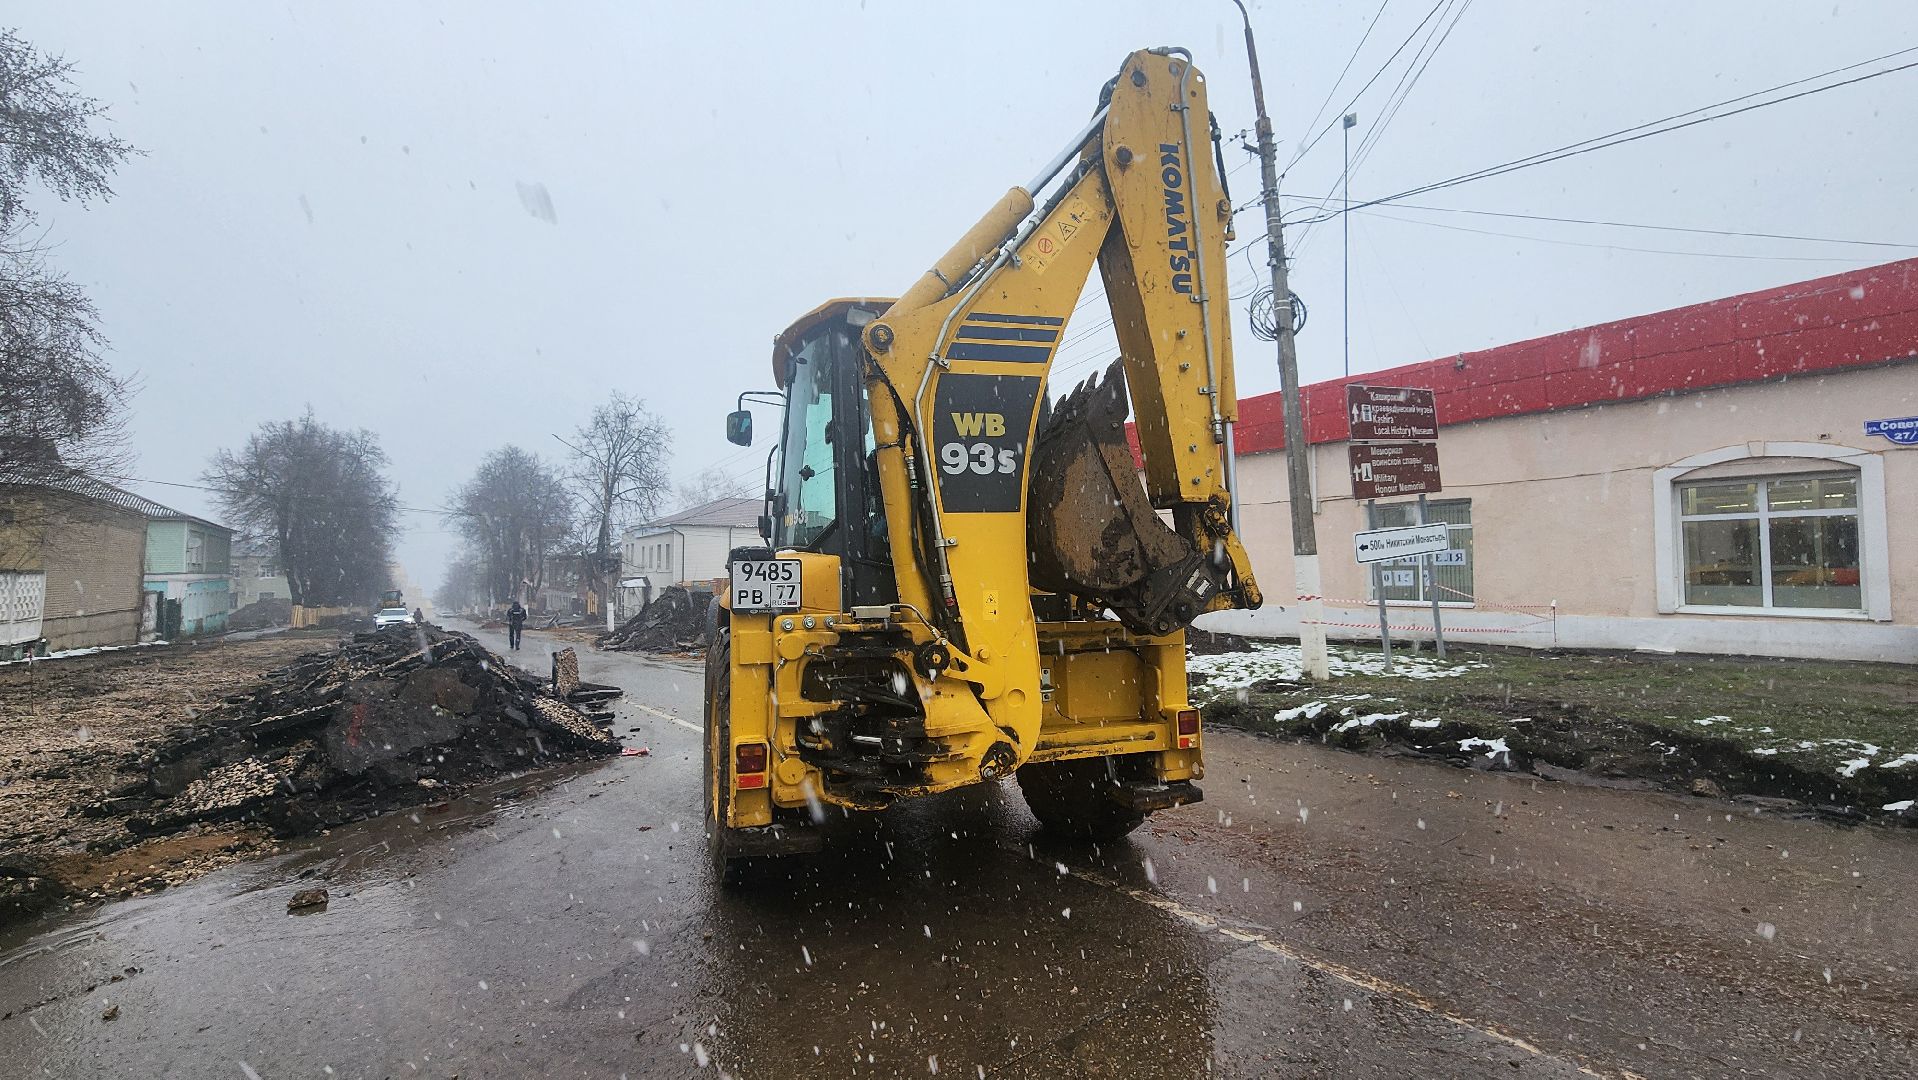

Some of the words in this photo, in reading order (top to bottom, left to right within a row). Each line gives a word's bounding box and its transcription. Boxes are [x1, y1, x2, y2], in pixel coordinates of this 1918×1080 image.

[1159, 143, 1197, 294] KOMATSU
[1416, 405, 1434, 415] музей
[950, 412, 1006, 437] WB
[1372, 414, 1394, 424] Kashira
[1373, 425, 1390, 435] Local
[1391, 425, 1411, 436] History
[1411, 426, 1434, 435] Museum
[1370, 446, 1403, 456] Мемориал
[941, 442, 1017, 475] 93s
[1371, 457, 1401, 467] воинской
[1402, 457, 1423, 465] славы
[1373, 474, 1397, 483] Military
[1375, 484, 1398, 494] Honour
[1399, 481, 1426, 492] Memorial
[1385, 535, 1415, 549] Никитский
[1415, 534, 1446, 545] Монастырь
[741, 562, 793, 582] 9485
[738, 589, 763, 605] РВ
[776, 585, 796, 599] 77
